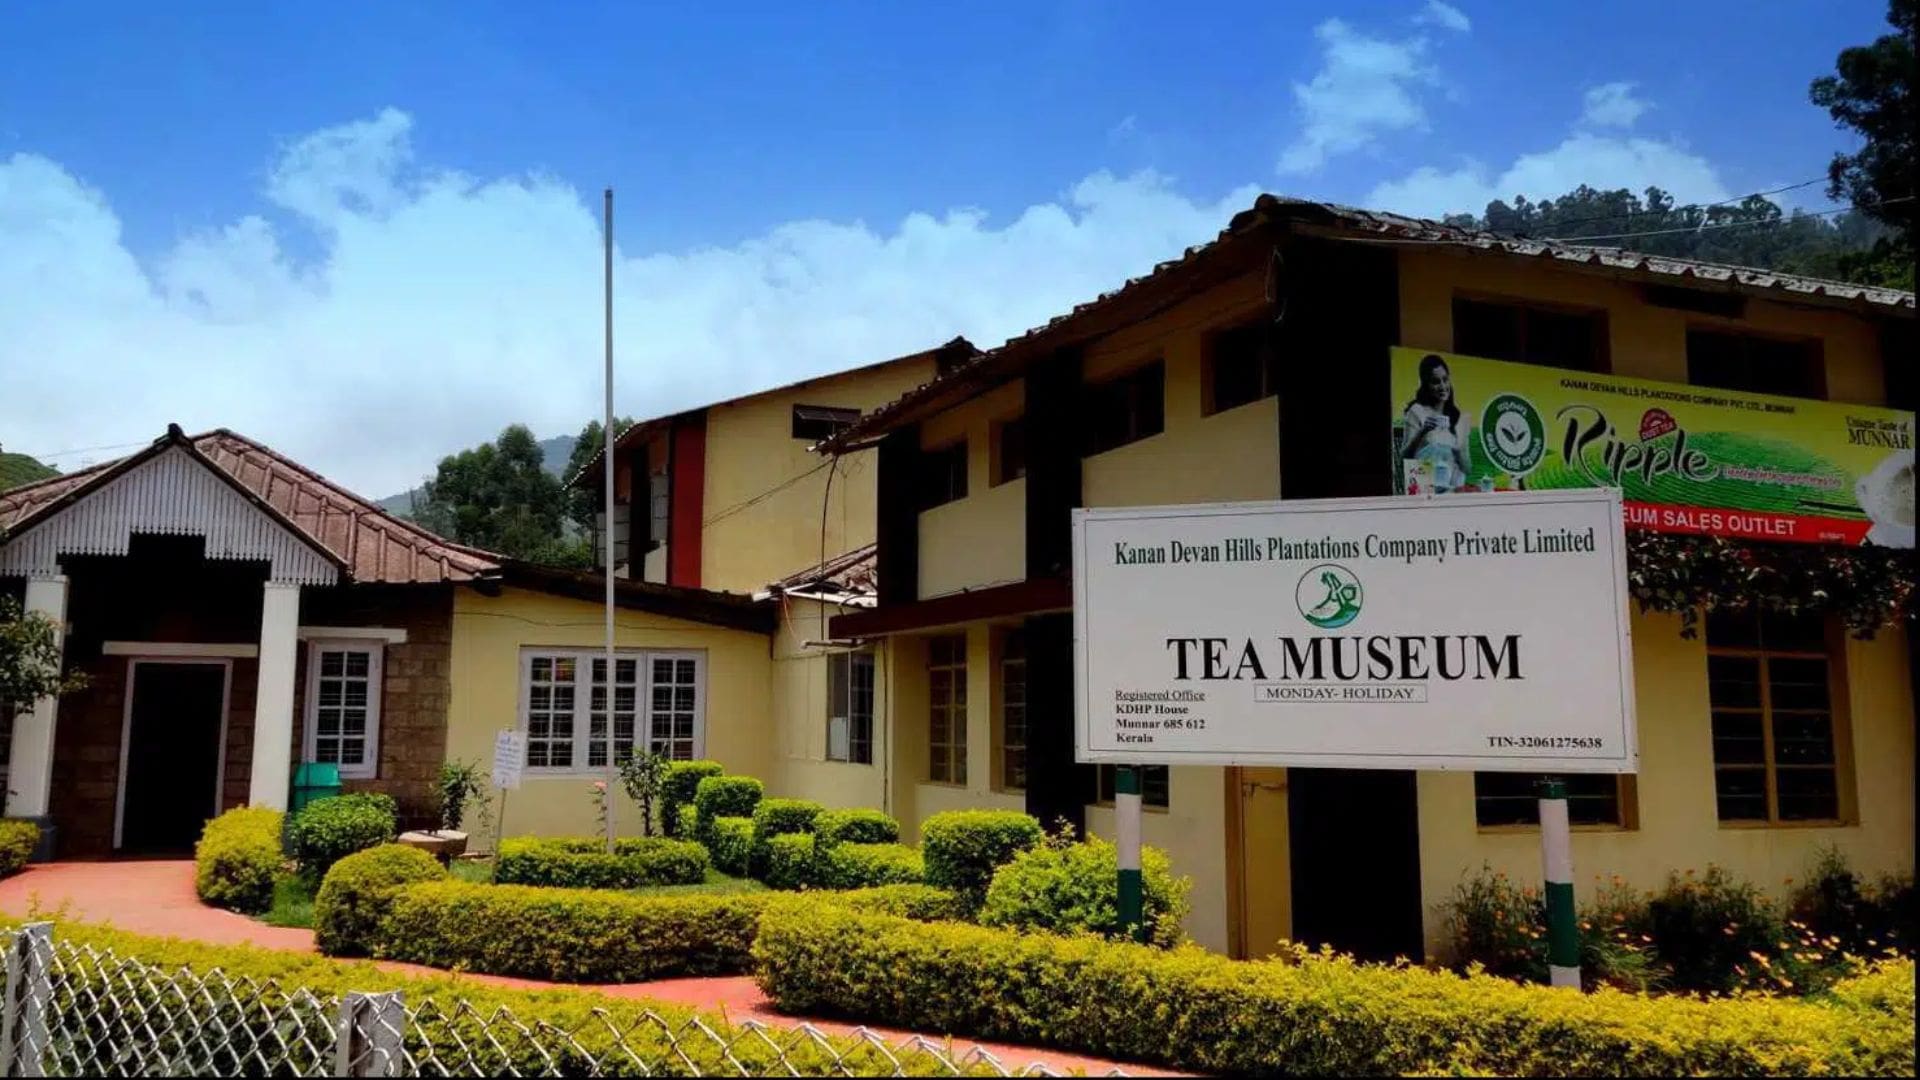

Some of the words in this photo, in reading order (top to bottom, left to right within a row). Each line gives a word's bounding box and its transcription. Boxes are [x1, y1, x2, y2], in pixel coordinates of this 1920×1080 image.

[1560, 379, 1588, 390] KANAN
[1618, 386, 1640, 397] HILLS
[1641, 389, 1691, 402] PLANTATIONS
[1693, 395, 1728, 406] COMPANY
[1555, 404, 1720, 486] Ripple
[1848, 428, 1910, 449] MUNNAR
[1623, 506, 1658, 525] EUM
[1664, 510, 1723, 530] SALES
[1728, 515, 1797, 536] OUTLET
[1115, 541, 1166, 565] Kanan
[1170, 540, 1220, 563] Devan
[1225, 537, 1262, 562] Hills
[1267, 535, 1360, 561] Plantations
[1365, 533, 1447, 564] Company
[1454, 530, 1518, 556] Private
[1523, 527, 1595, 554] Limited
[1166, 636, 1268, 681] TEA
[1278, 634, 1525, 681] MUSEUM
[1115, 690, 1169, 702] Registered
[1171, 690, 1205, 702] Office
[1266, 687, 1340, 699] MONDAY-
[1343, 687, 1415, 699] HOLIDAY
[1115, 704, 1152, 714] KDHP
[1155, 704, 1189, 714] House
[1116, 719, 1161, 729] Munnar
[1163, 719, 1183, 729] 685
[1186, 719, 1205, 729] 612
[1116, 733, 1153, 743] Kerala
[1487, 736, 1603, 749] TIN-32061275638
